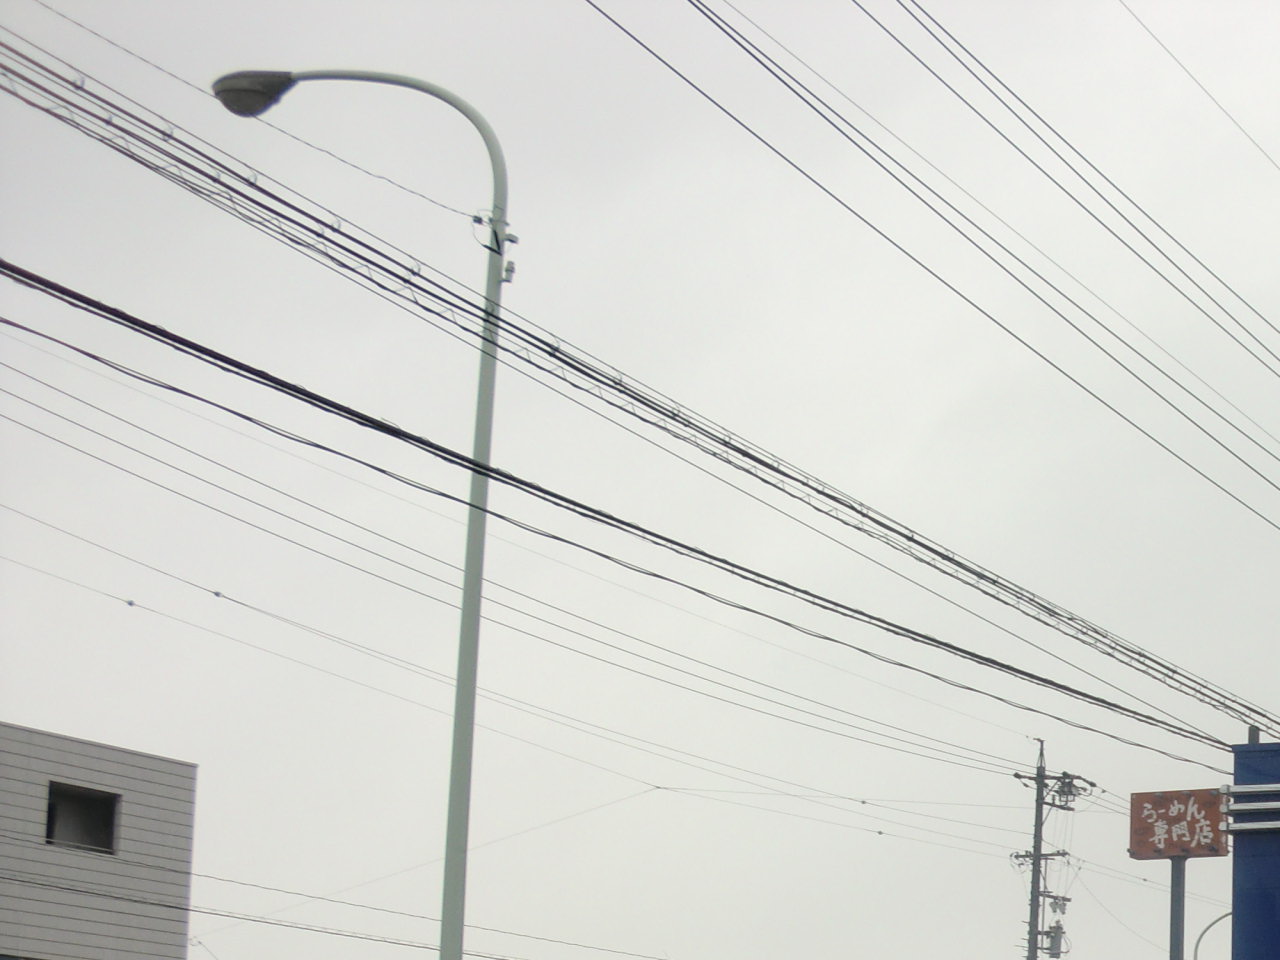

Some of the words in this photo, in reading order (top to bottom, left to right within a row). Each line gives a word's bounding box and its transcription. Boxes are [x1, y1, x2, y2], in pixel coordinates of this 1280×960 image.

[1141, 796, 1206, 823] らーめん
[1149, 818, 1214, 849] 専門店
